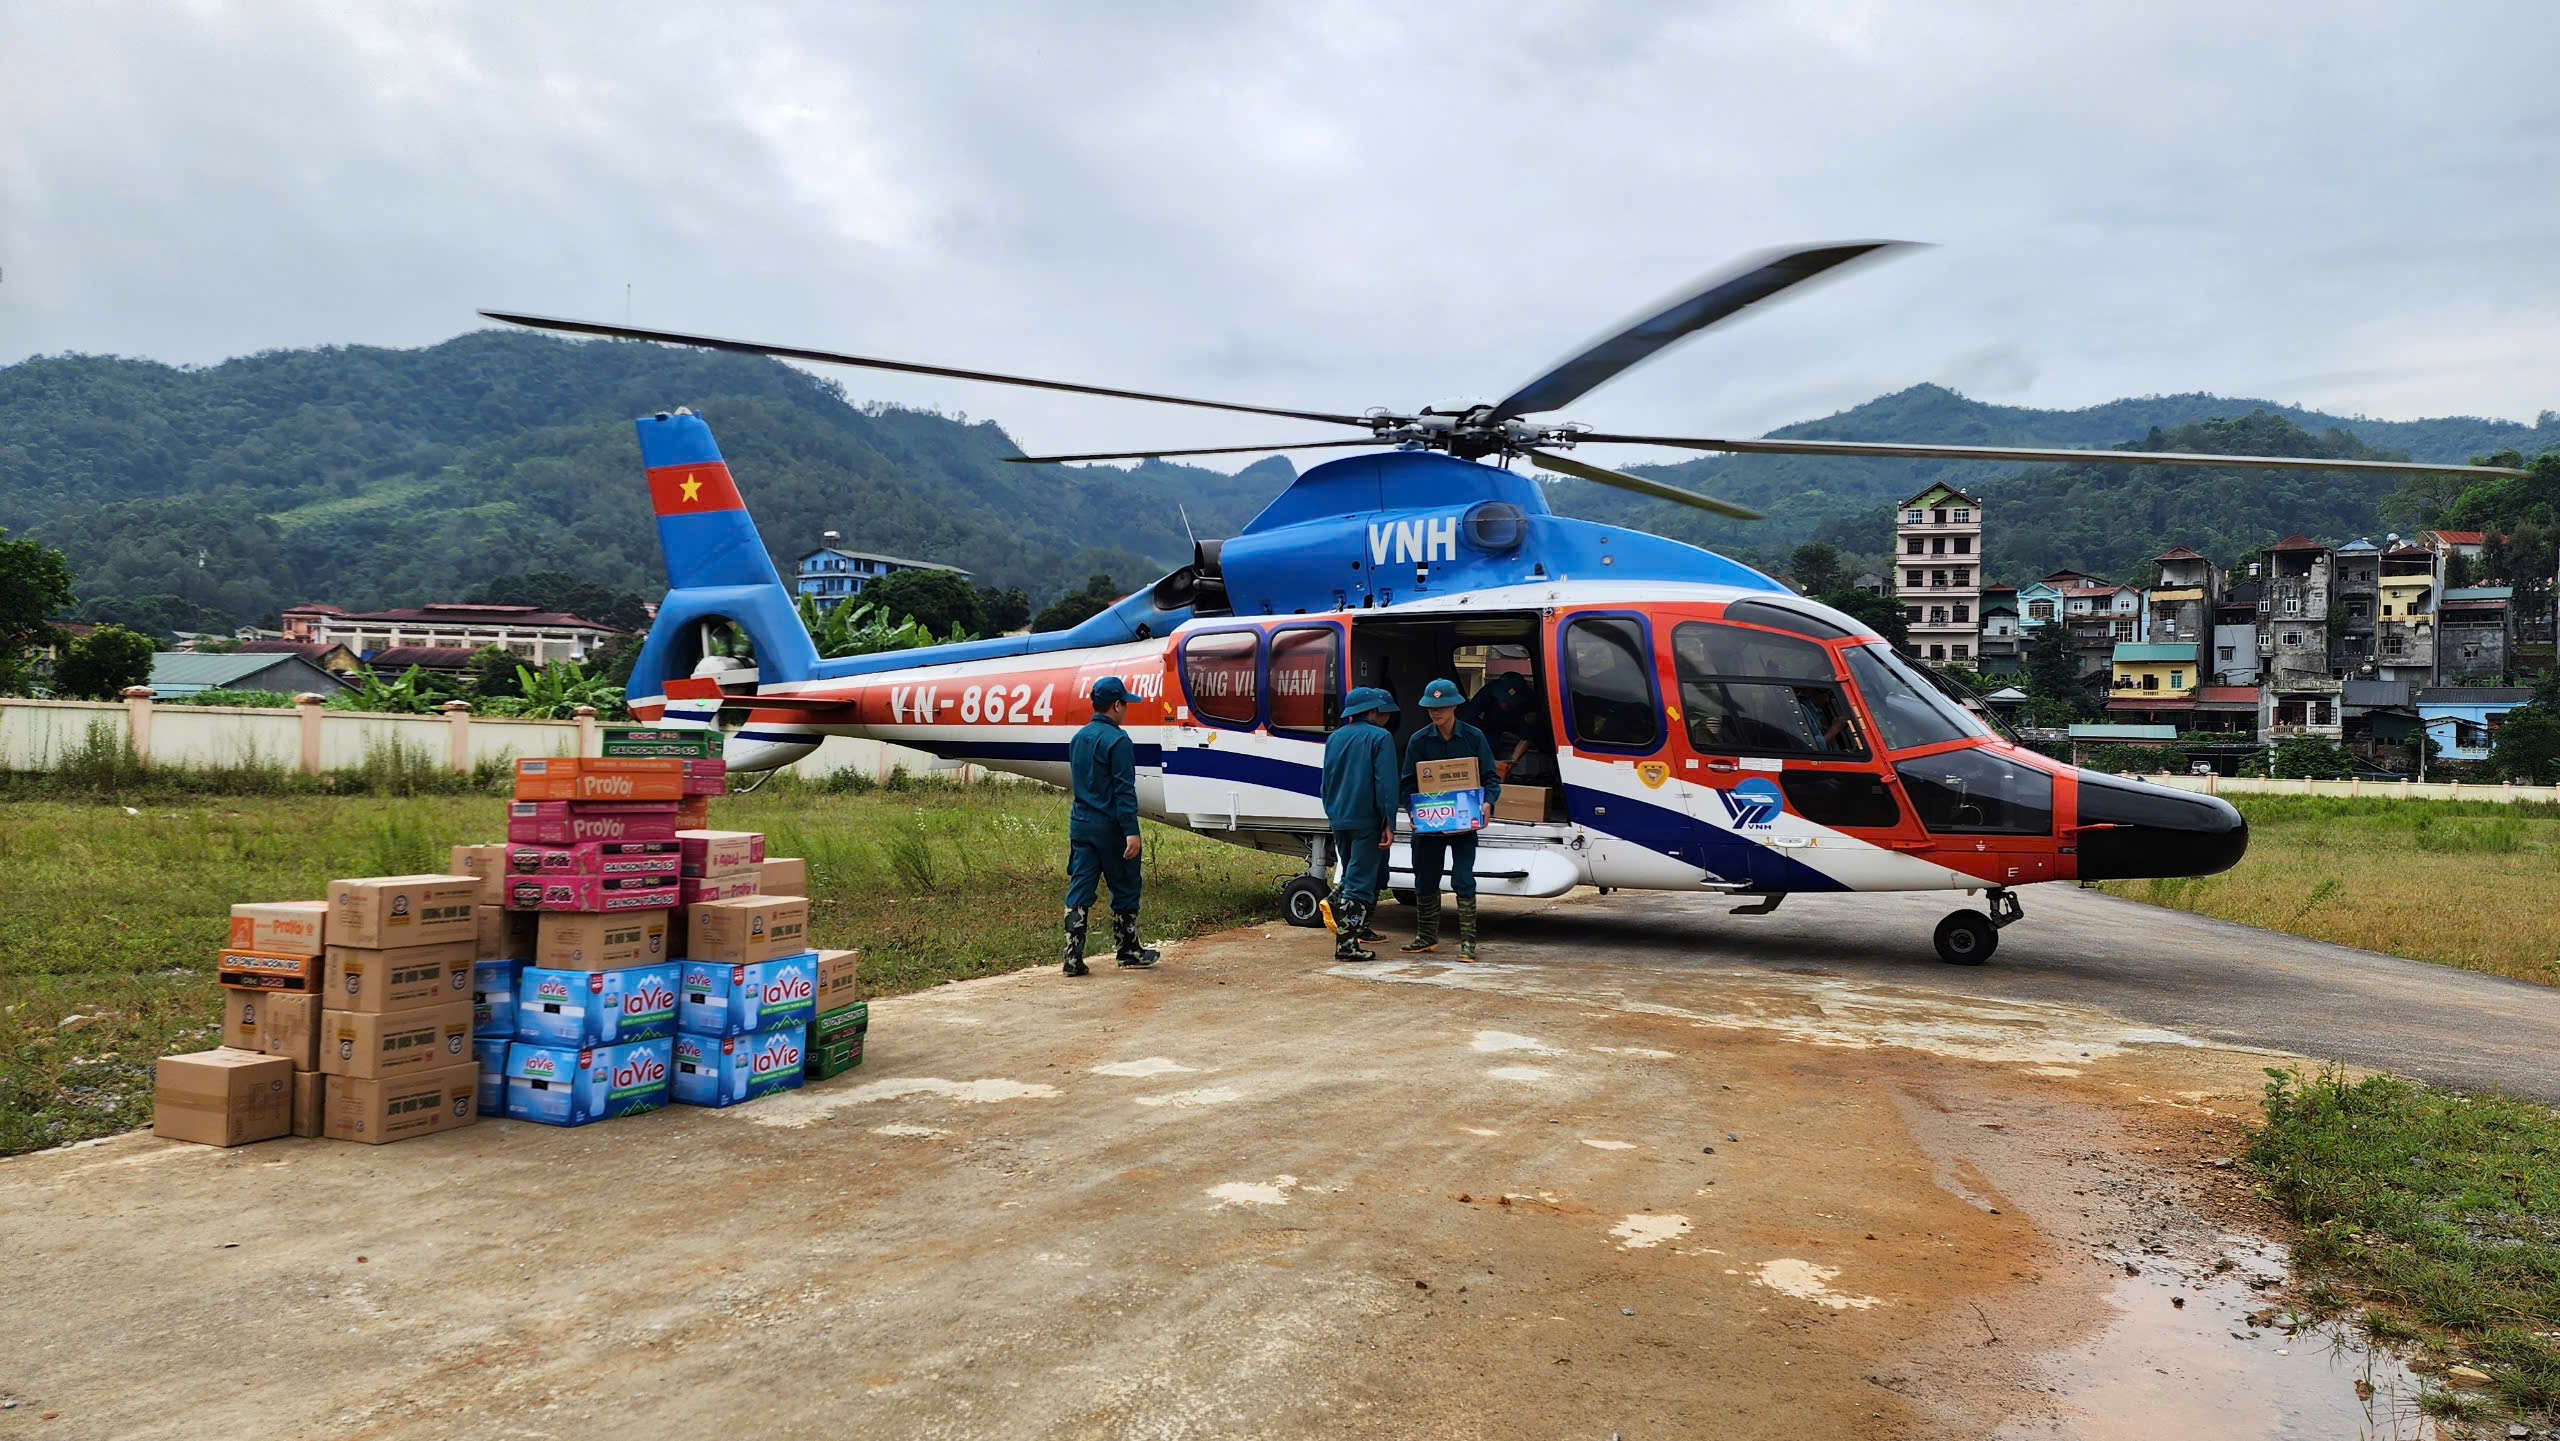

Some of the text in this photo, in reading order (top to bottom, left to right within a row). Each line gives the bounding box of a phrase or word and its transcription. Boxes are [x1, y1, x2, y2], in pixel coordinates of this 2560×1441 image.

[1369, 517, 1456, 565] VNH
[1132, 670, 1164, 703] TRỰ
[1278, 669, 1316, 696] NAM
[891, 684, 1054, 724] VN-8624
[584, 776, 633, 797] ProYo!
[1417, 807, 1455, 821] laVie
[573, 818, 625, 840] ProYo!
[539, 982, 567, 996] laVie
[686, 973, 711, 987] laVie
[763, 976, 812, 1003] laVie
[624, 986, 674, 1014] laVie
[526, 1056, 554, 1071] laVie
[753, 1044, 799, 1072] laVie
[613, 1059, 665, 1088] laVie
